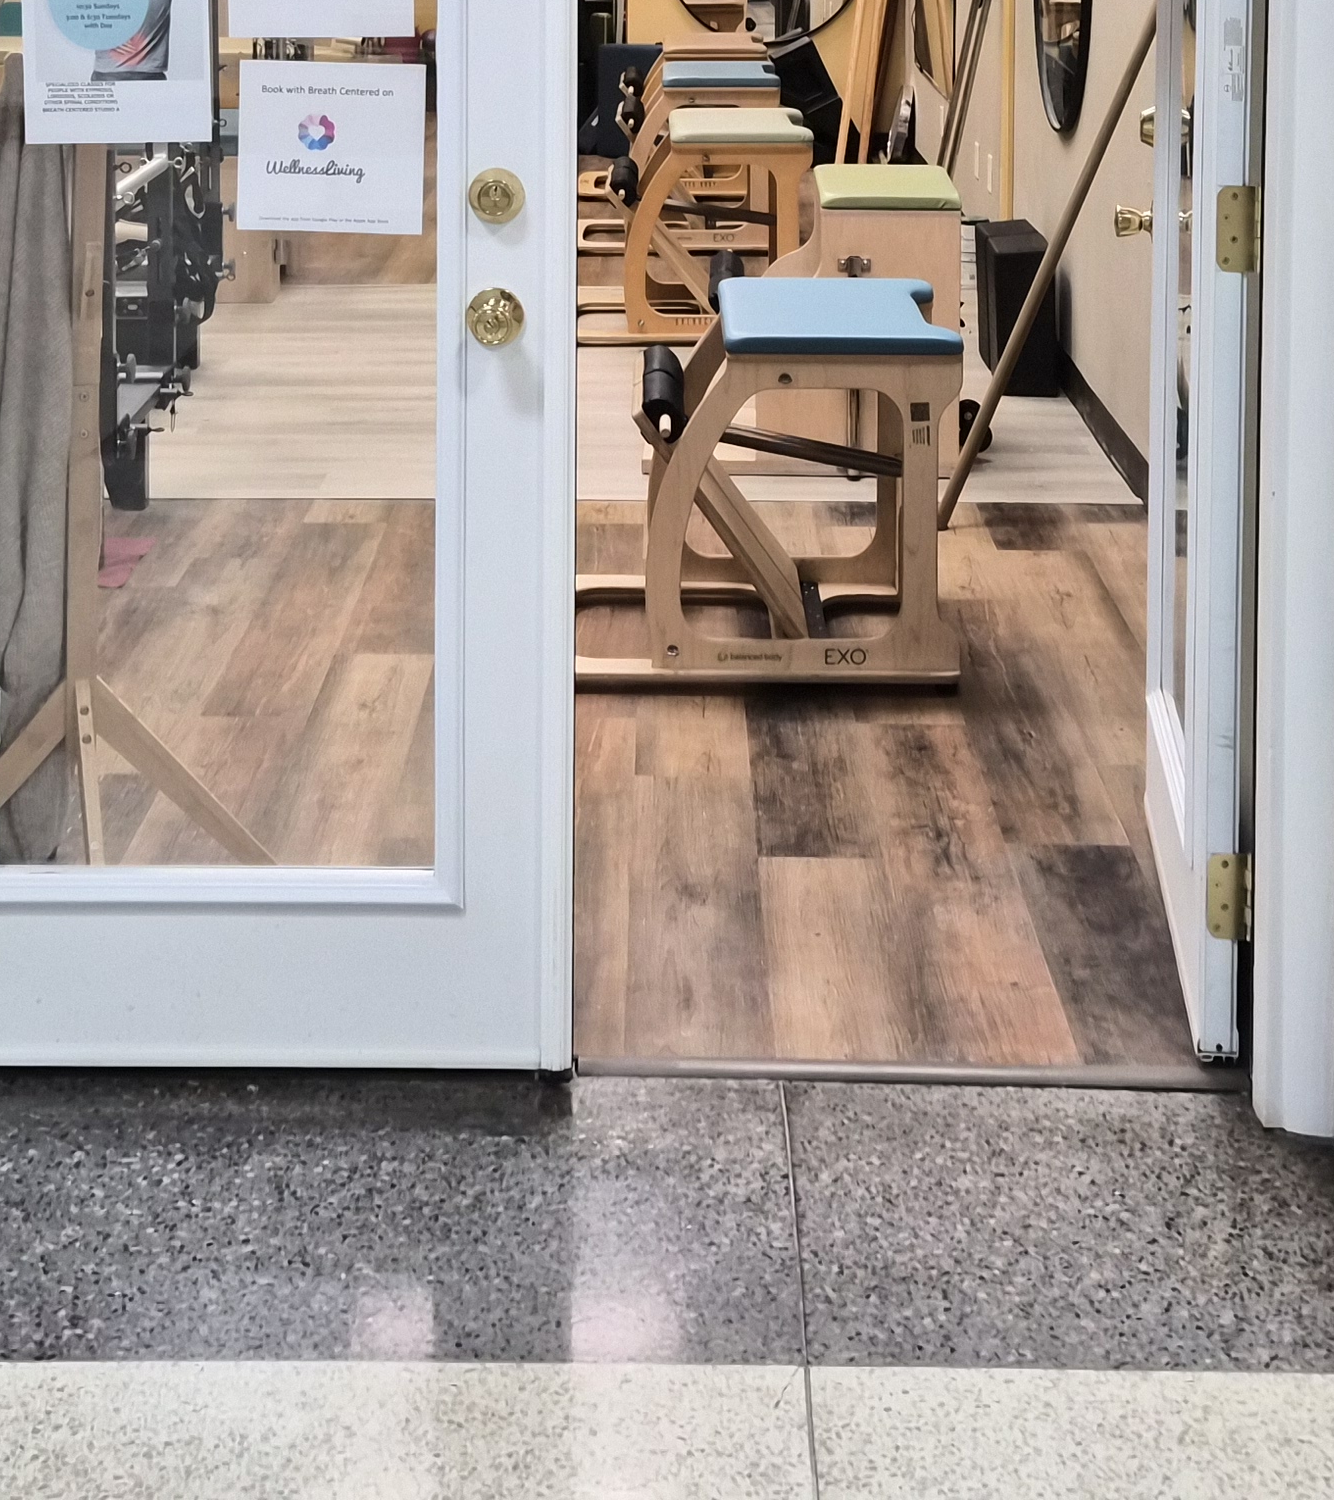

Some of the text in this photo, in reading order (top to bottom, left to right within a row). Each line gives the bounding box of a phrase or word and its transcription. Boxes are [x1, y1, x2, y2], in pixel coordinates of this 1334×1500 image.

[101, 13, 131, 21] Tuesdays
[261, 85, 284, 94] Book
[286, 86, 306, 95] with
[307, 86, 337, 95] Breath
[339, 87, 380, 97] Centered
[265, 159, 366, 184] WellnessLiving
[713, 233, 735, 243] EXO
[824, 648, 867, 665] EXO
